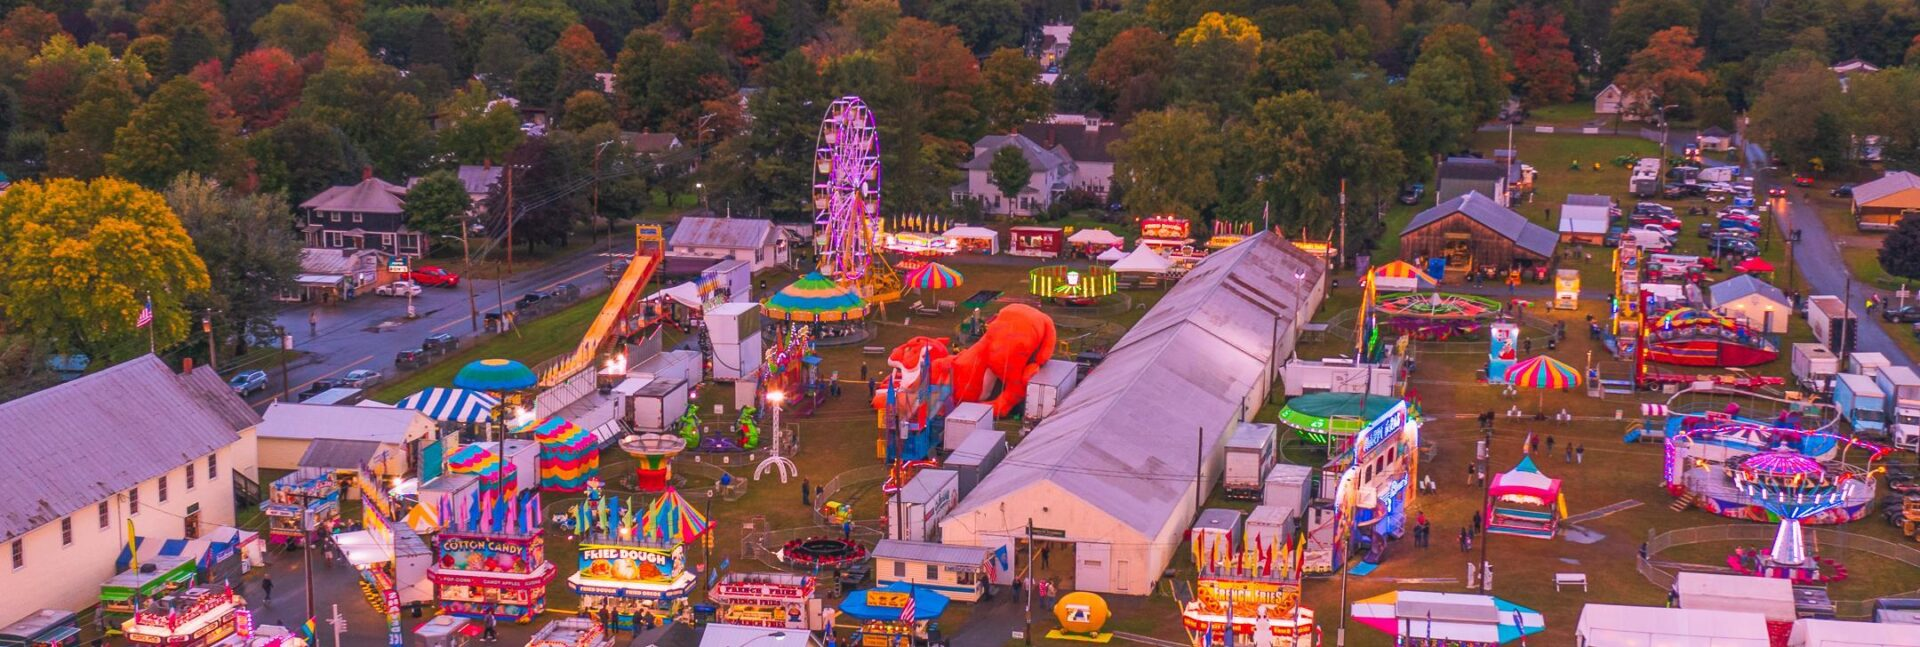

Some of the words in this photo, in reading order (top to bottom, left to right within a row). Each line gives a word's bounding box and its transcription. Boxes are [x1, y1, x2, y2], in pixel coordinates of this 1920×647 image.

[444, 540, 485, 551] COTTON
[488, 543, 523, 554] CANDY
[584, 550, 619, 560] FRIED
[620, 550, 666, 565] DOUGH
[1214, 587, 1251, 602] FRENCH
[1255, 590, 1282, 604] FRIES
